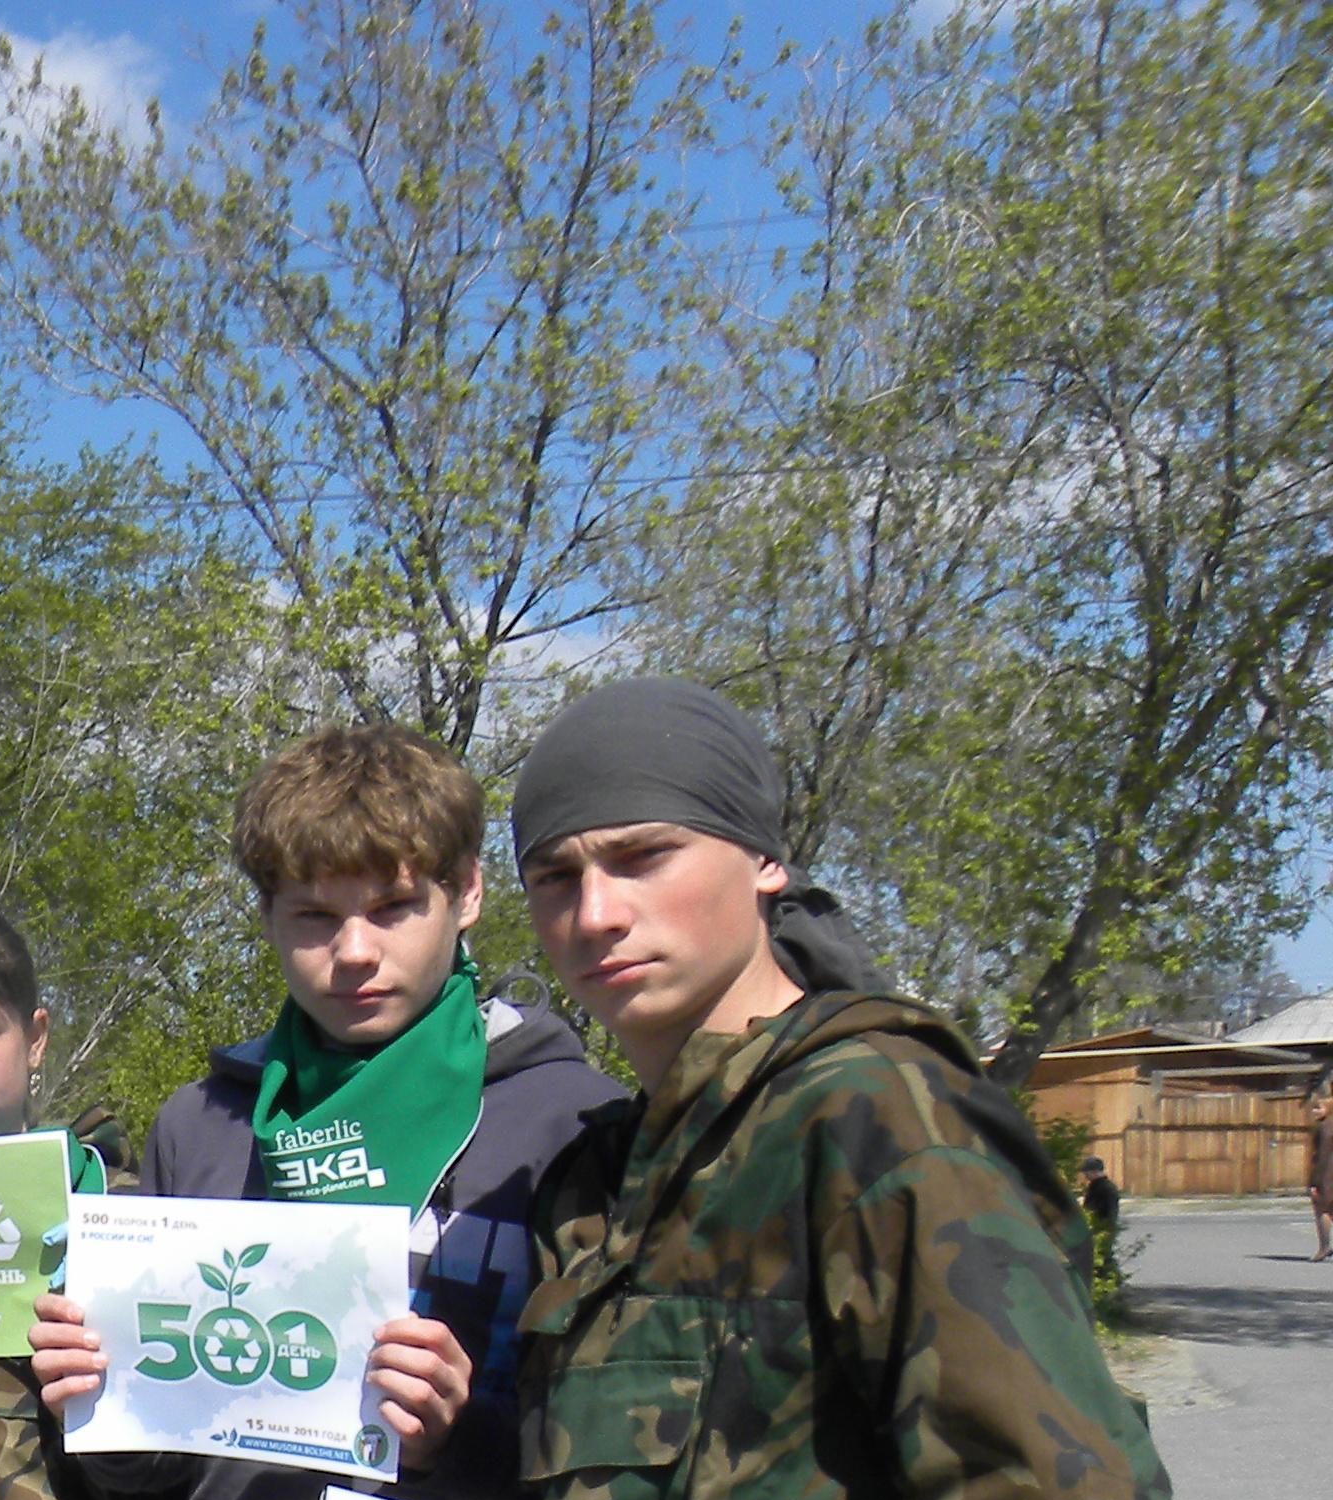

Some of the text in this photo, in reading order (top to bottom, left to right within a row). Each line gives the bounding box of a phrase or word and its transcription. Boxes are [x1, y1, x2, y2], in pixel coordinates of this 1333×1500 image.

[275, 1119, 362, 1152] faberlic
[82, 1212, 109, 1225] 500
[161, 1216, 168, 1228] 1
[277, 1344, 323, 1360] ДЕНЬ
[246, 1418, 348, 1442] 15 МАЯ 2011 ГОДА
